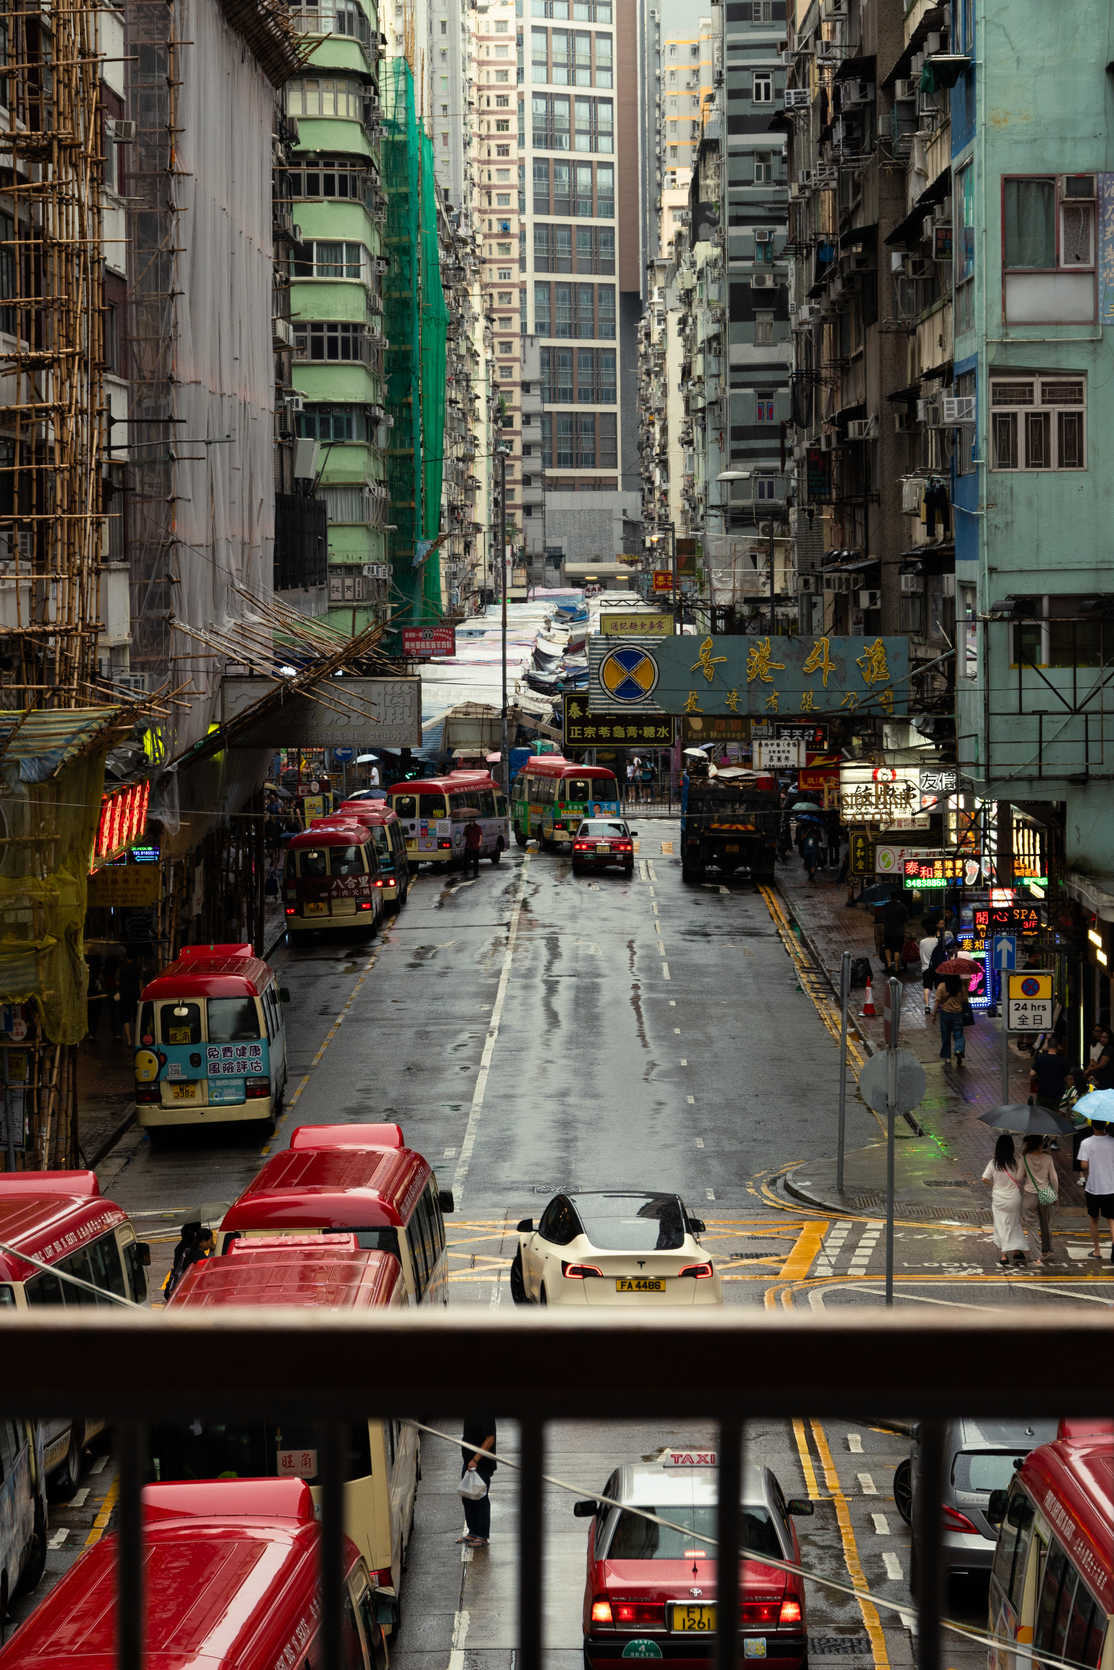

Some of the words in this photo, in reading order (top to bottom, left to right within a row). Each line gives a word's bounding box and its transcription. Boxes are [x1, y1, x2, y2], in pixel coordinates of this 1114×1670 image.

[905, 861, 934, 879] 泰和
[331, 876, 369, 888] 八合里
[976, 911, 1009, 924] 開心
[1013, 909, 1039, 920] SPA
[962, 939, 985, 951] 泰和
[1014, 1002, 1027, 1011] 24
[1031, 1001, 1047, 1011] hrs
[1017, 1014, 1043, 1025] 全日
[207, 1044, 262, 1059] 免費健康
[208, 1060, 263, 1074] 風險評估
[620, 1281, 632, 1290] FA
[670, 1454, 716, 1465] TAXI
[682, 1618, 711, 1631] 1261
